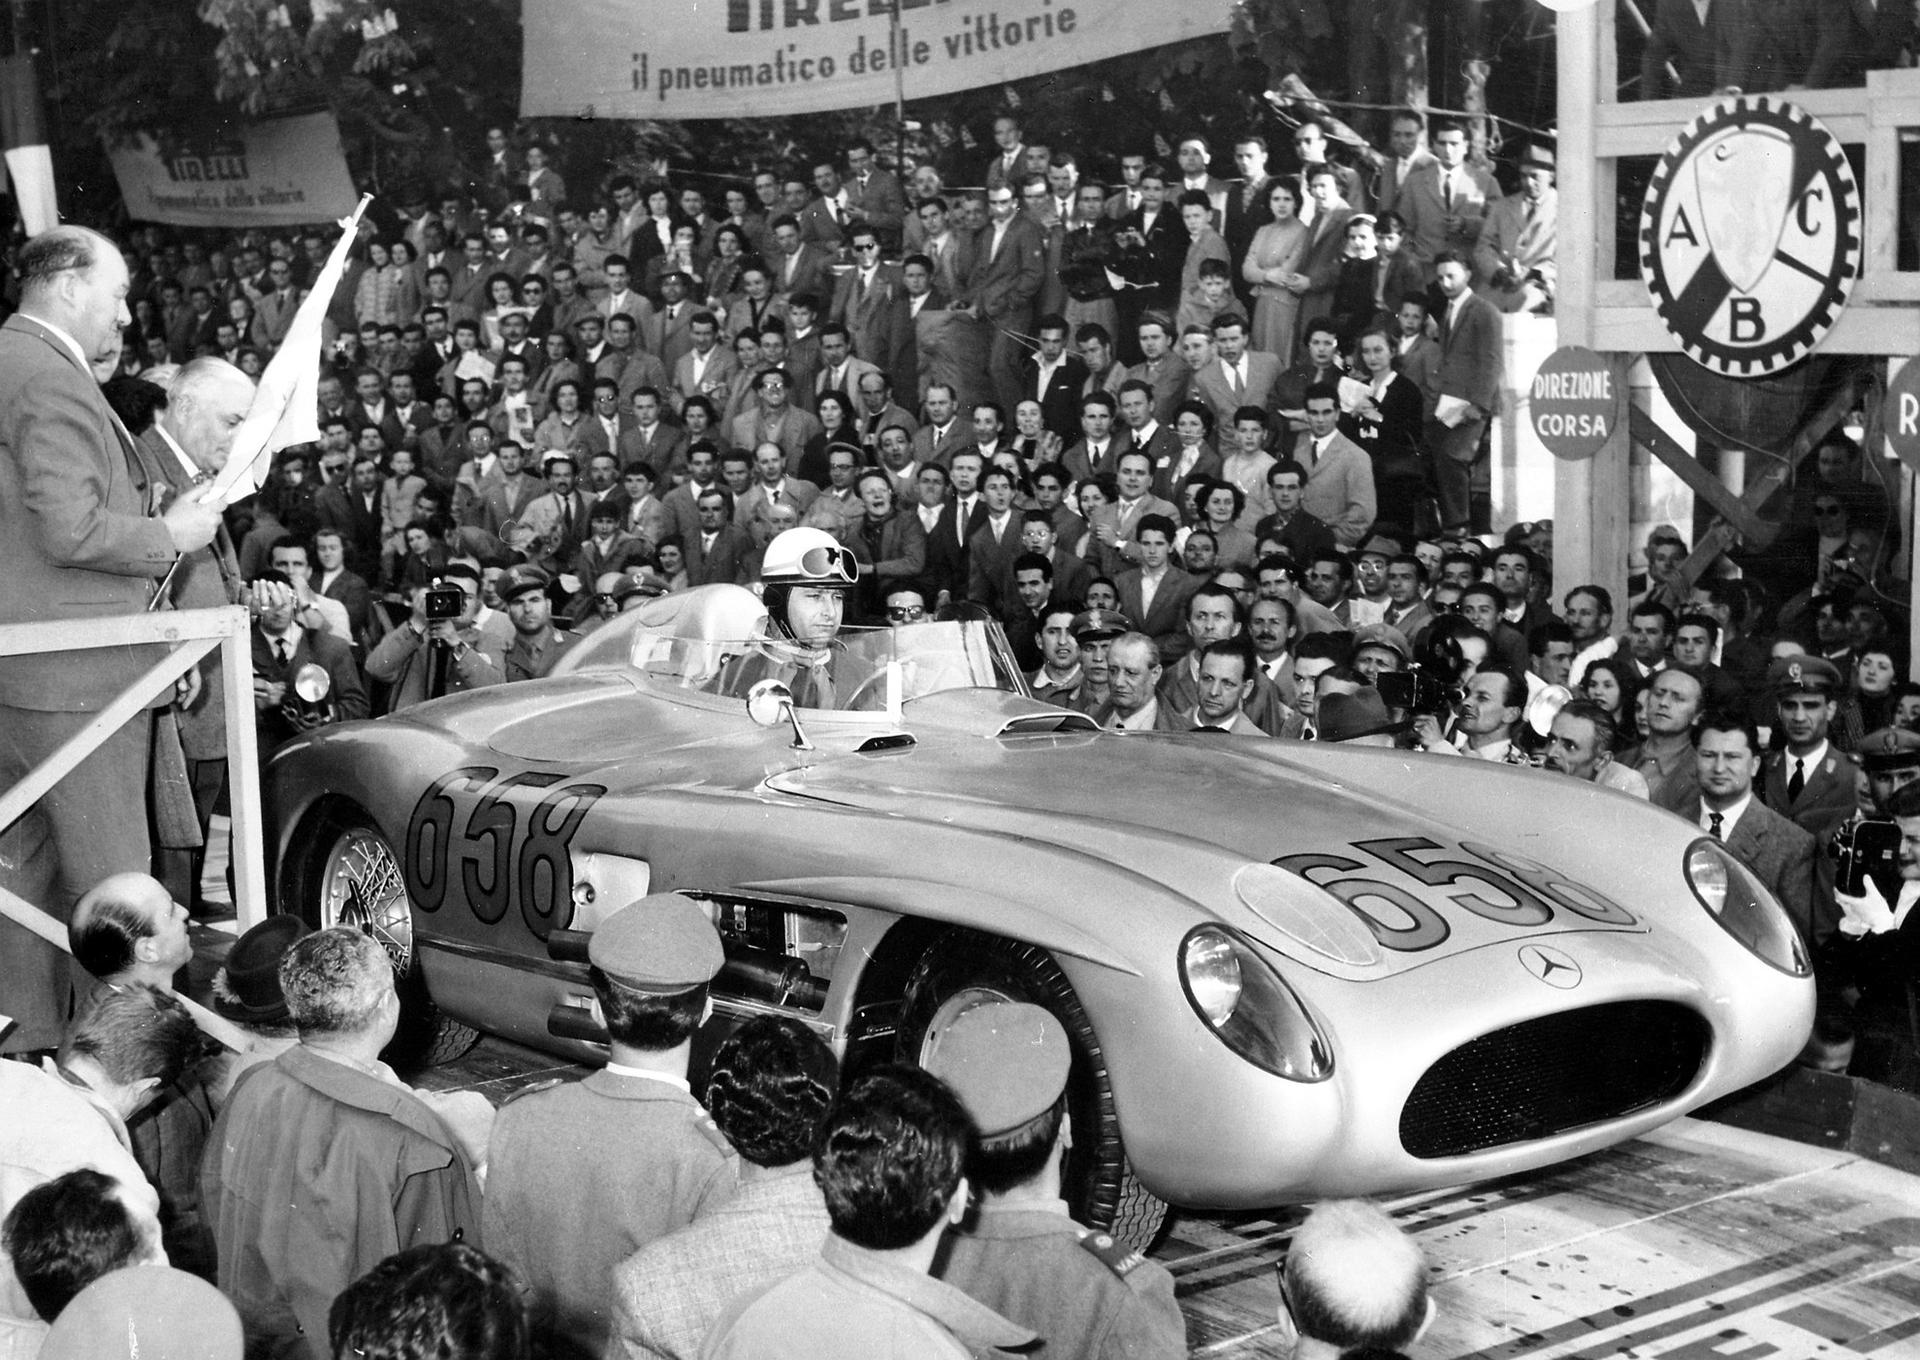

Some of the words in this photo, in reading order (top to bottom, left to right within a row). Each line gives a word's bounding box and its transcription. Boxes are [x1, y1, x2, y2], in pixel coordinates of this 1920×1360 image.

[632, 52, 648, 90] il
[658, 43, 835, 101] pneumatico
[849, 35, 930, 74] delle
[944, 7, 1077, 59] vittorie
[1665, 203, 1699, 248] A
[1796, 188, 1824, 236] C
[1729, 297, 1766, 342] B
[1534, 370, 1612, 399] DIREZIONE
[1537, 414, 1607, 437] CORSA
[405, 766, 608, 943] 658
[1271, 837, 1637, 952] 658
